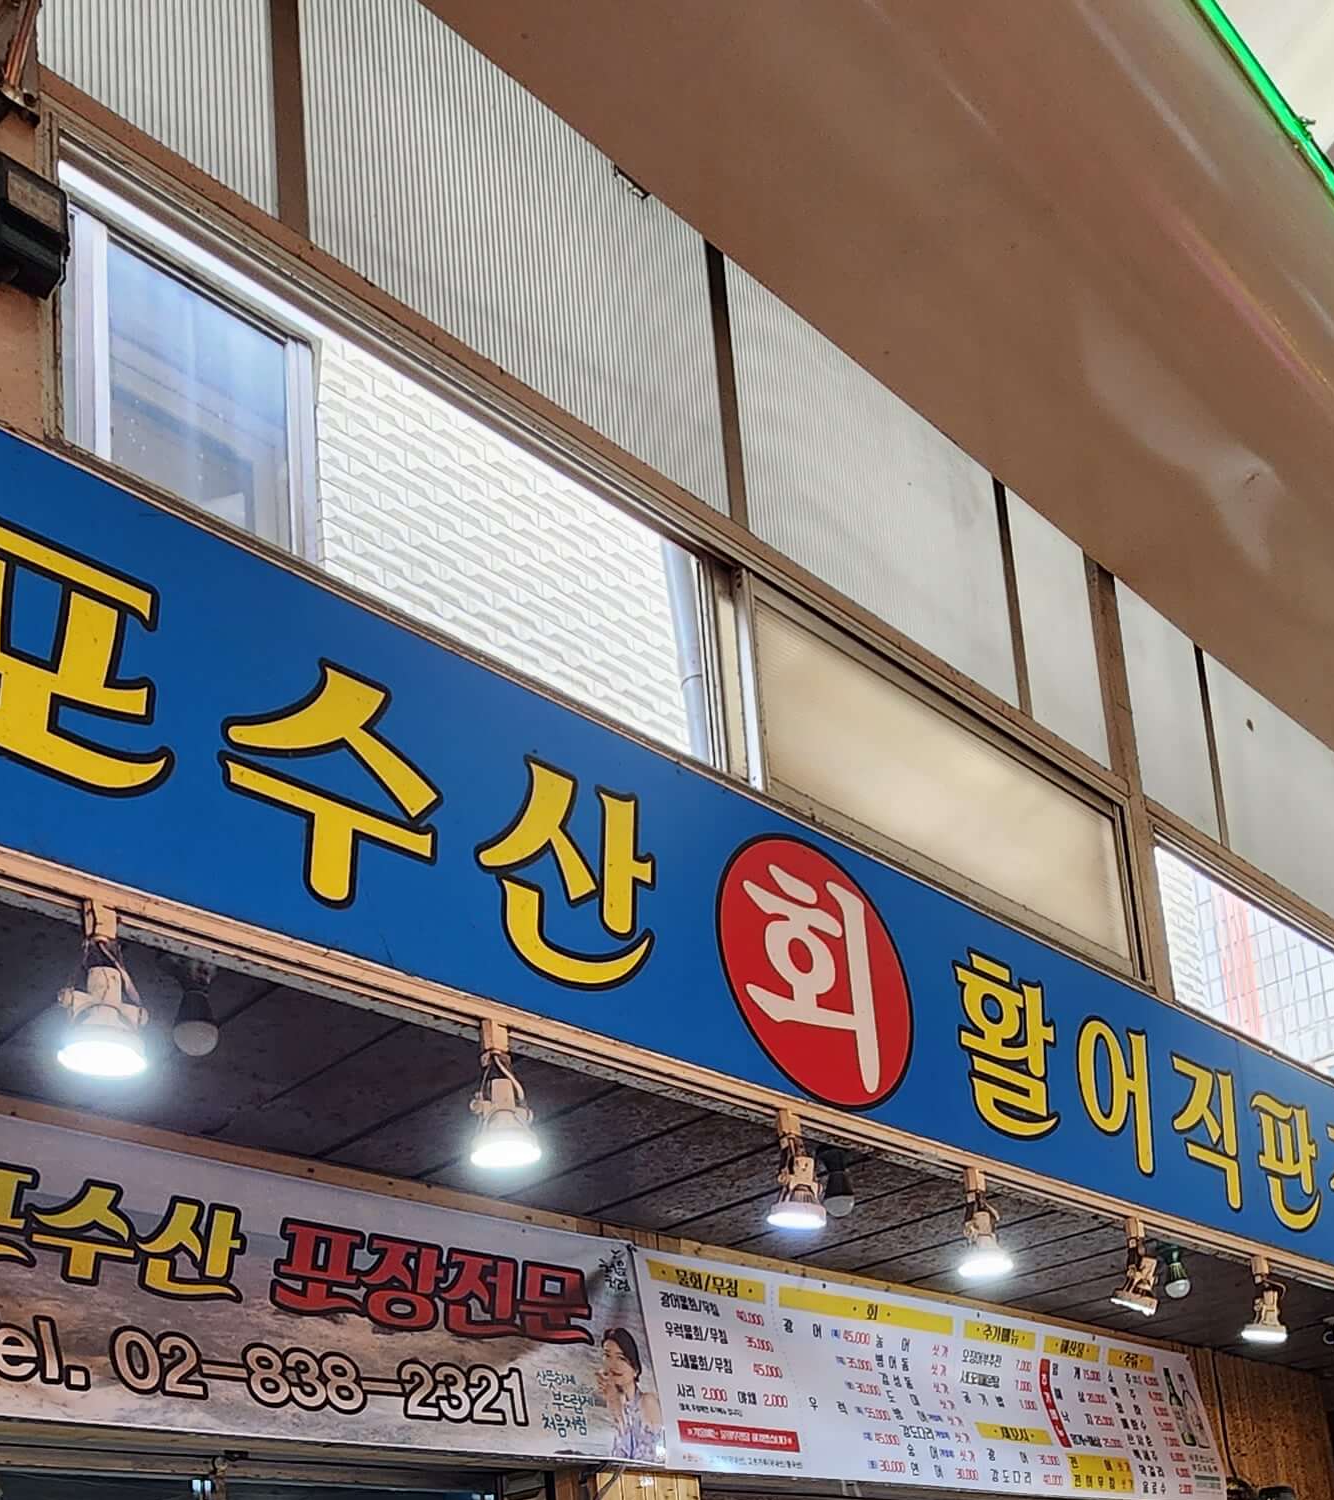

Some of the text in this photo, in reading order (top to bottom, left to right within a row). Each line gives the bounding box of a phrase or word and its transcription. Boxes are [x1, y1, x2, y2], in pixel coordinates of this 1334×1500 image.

[742, 864, 882, 1096] 회
[270, 1216, 594, 1345] 포장전문
[114, 1325, 529, 1428] 02-838-2321
